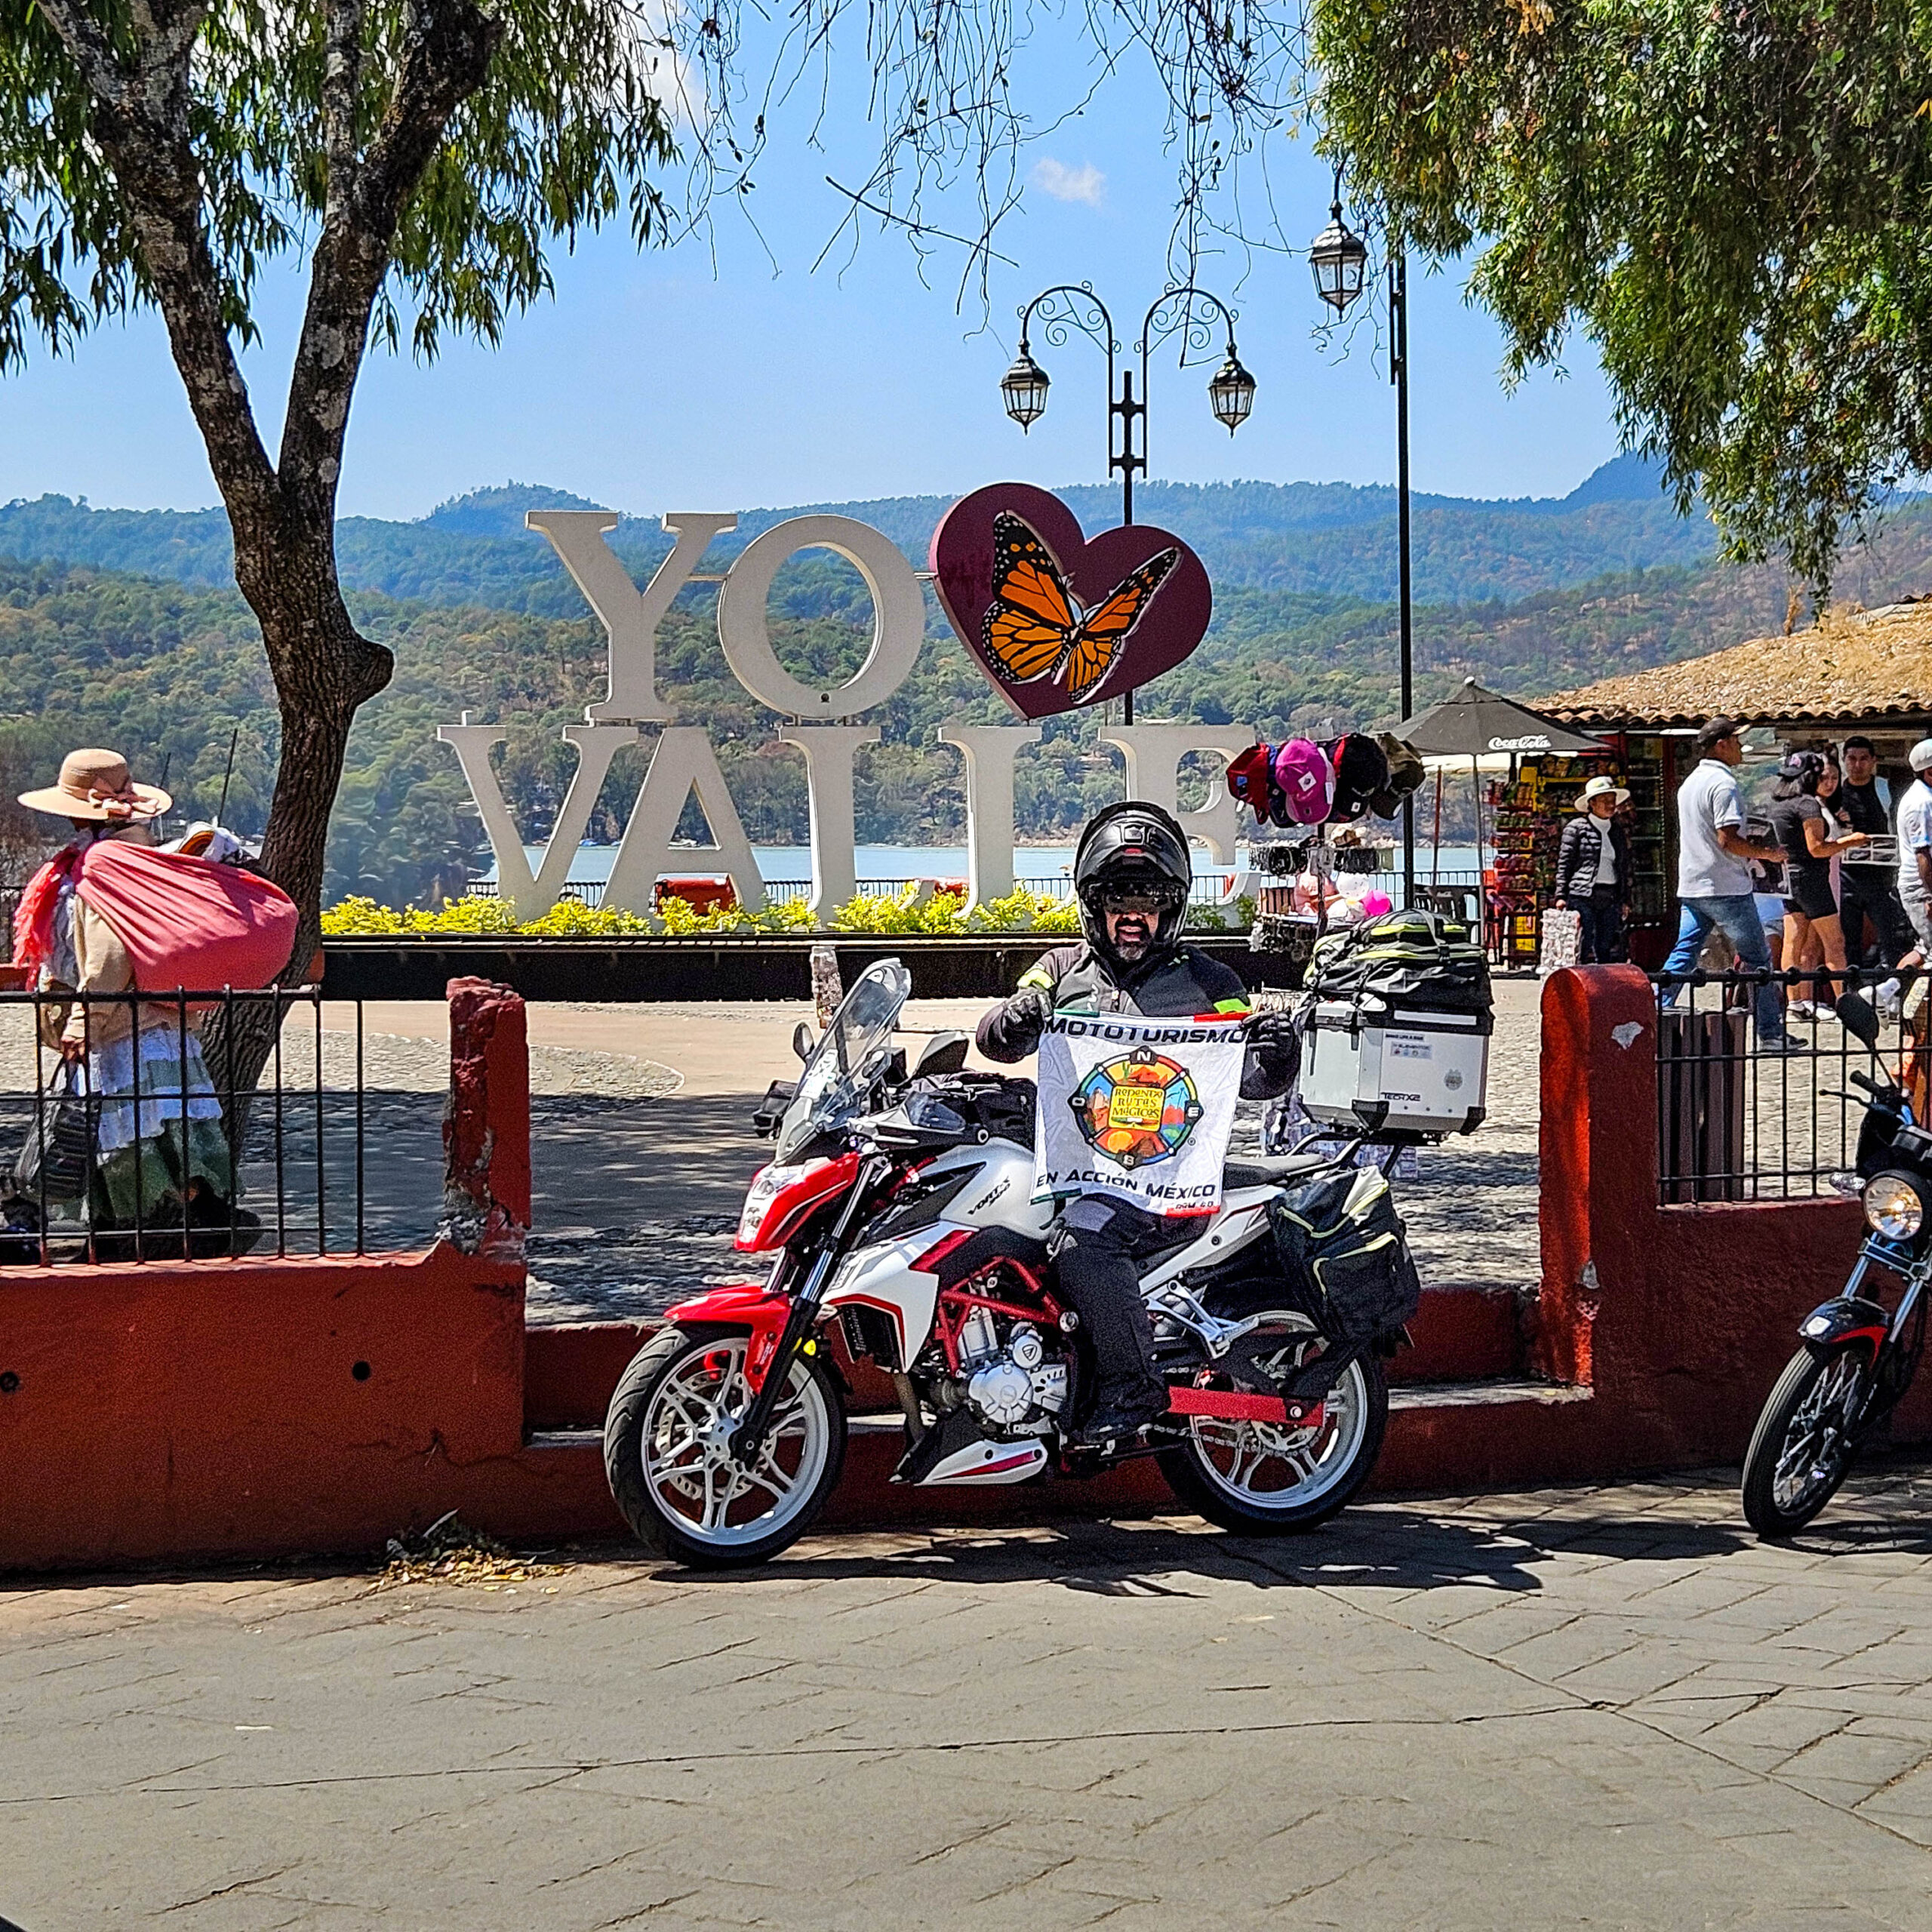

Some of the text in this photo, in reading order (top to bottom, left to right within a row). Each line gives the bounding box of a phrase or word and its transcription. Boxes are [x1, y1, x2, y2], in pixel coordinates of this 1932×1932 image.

[526, 510, 925, 722] YO
[437, 724, 1260, 930] VALLE
[1044, 1017, 1249, 1044] MOTOTURISMO
[1137, 1051, 1152, 1062] N
[1188, 1106, 1200, 1118] E
[1035, 1168, 1216, 1200] EN ACCIÓN MÉXICO
